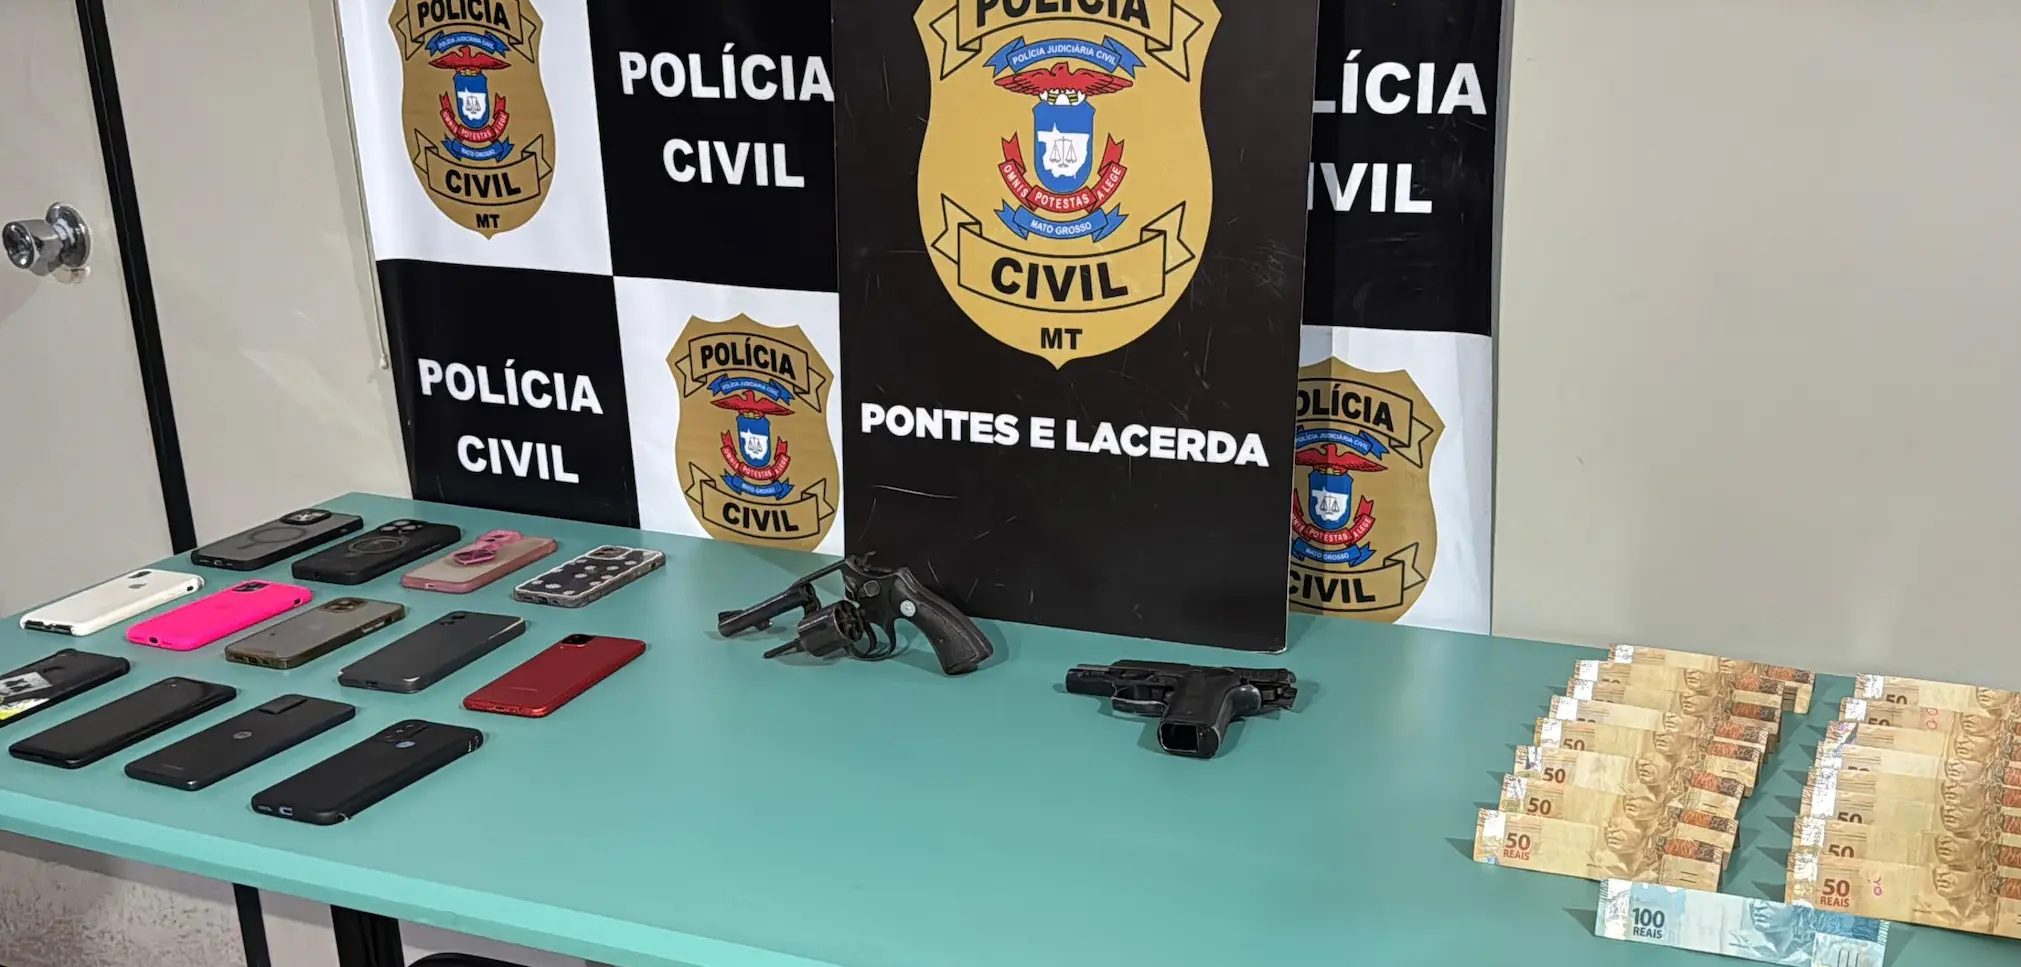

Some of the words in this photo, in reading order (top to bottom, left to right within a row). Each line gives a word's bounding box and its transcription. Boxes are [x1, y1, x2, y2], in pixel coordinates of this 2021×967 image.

[1012, 47, 1045, 66] POLÍCIA
[1096, 50, 1117, 66] CIVIL
[619, 42, 835, 103] POLÍCIA
[662, 138, 805, 188] CIVIL
[445, 169, 522, 198] CIVIL
[1003, 164, 1029, 198] OMNIS
[1035, 191, 1090, 209] POTESTAS
[1105, 166, 1121, 192] LEGE
[476, 213, 500, 228] MT
[1030, 219, 1054, 234] MATO
[1055, 221, 1092, 235] GROSSO
[990, 257, 1129, 302] CIVIL
[1040, 327, 1083, 350] MT
[700, 338, 796, 381] POLÍCIA
[418, 358, 604, 415] POLÍCIA
[860, 402, 1020, 447] PONTES
[1029, 416, 1056, 449] E
[1065, 418, 1270, 468] LACERDA
[457, 434, 580, 484] CIVIL
[722, 502, 799, 532] CIVIL
[1309, 527, 1348, 542] POTESTAS
[1563, 738, 1585, 751] 50
[1542, 767, 1566, 784] 50
[1527, 797, 1552, 815] 50
[1837, 811, 1863, 824] 50
[1505, 832, 1531, 851] 50
[1828, 844, 1854, 858] 50
[1503, 849, 1530, 861] REAIS
[1822, 878, 1850, 897] 50
[1820, 896, 1850, 908] REAIS
[1632, 907, 1665, 929] 100
[1633, 926, 1663, 939] REAIS
